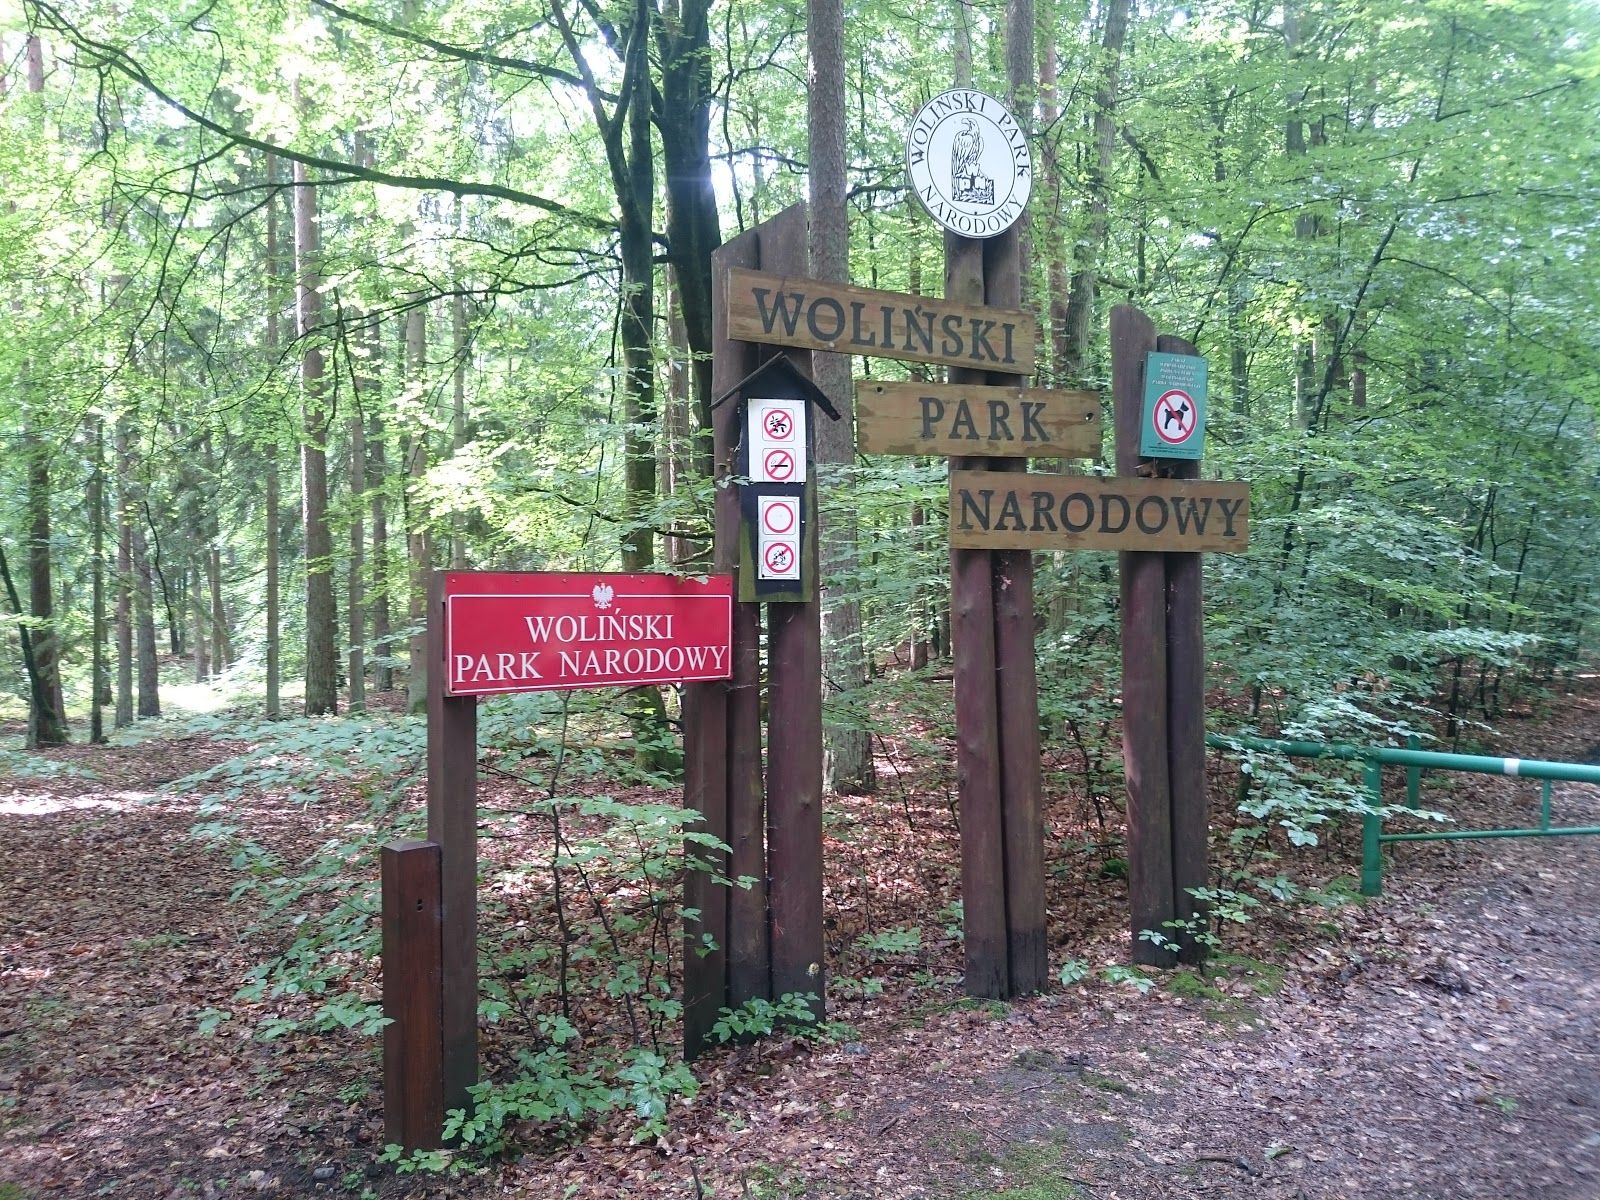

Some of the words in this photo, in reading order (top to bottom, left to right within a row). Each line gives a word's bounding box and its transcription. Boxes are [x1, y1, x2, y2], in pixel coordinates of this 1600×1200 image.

[912, 92, 986, 166] WOLIŃSKI
[998, 112, 1031, 179] PARK
[920, 184, 1024, 235] NARODOWY
[751, 286, 1017, 364] WOLIŃSKI
[918, 396, 1052, 442] PARK
[957, 488, 1245, 537] NARODOWY
[524, 608, 673, 643] WOLIŃSKI
[454, 652, 543, 683] PARK
[559, 645, 728, 678] NARODOWY
